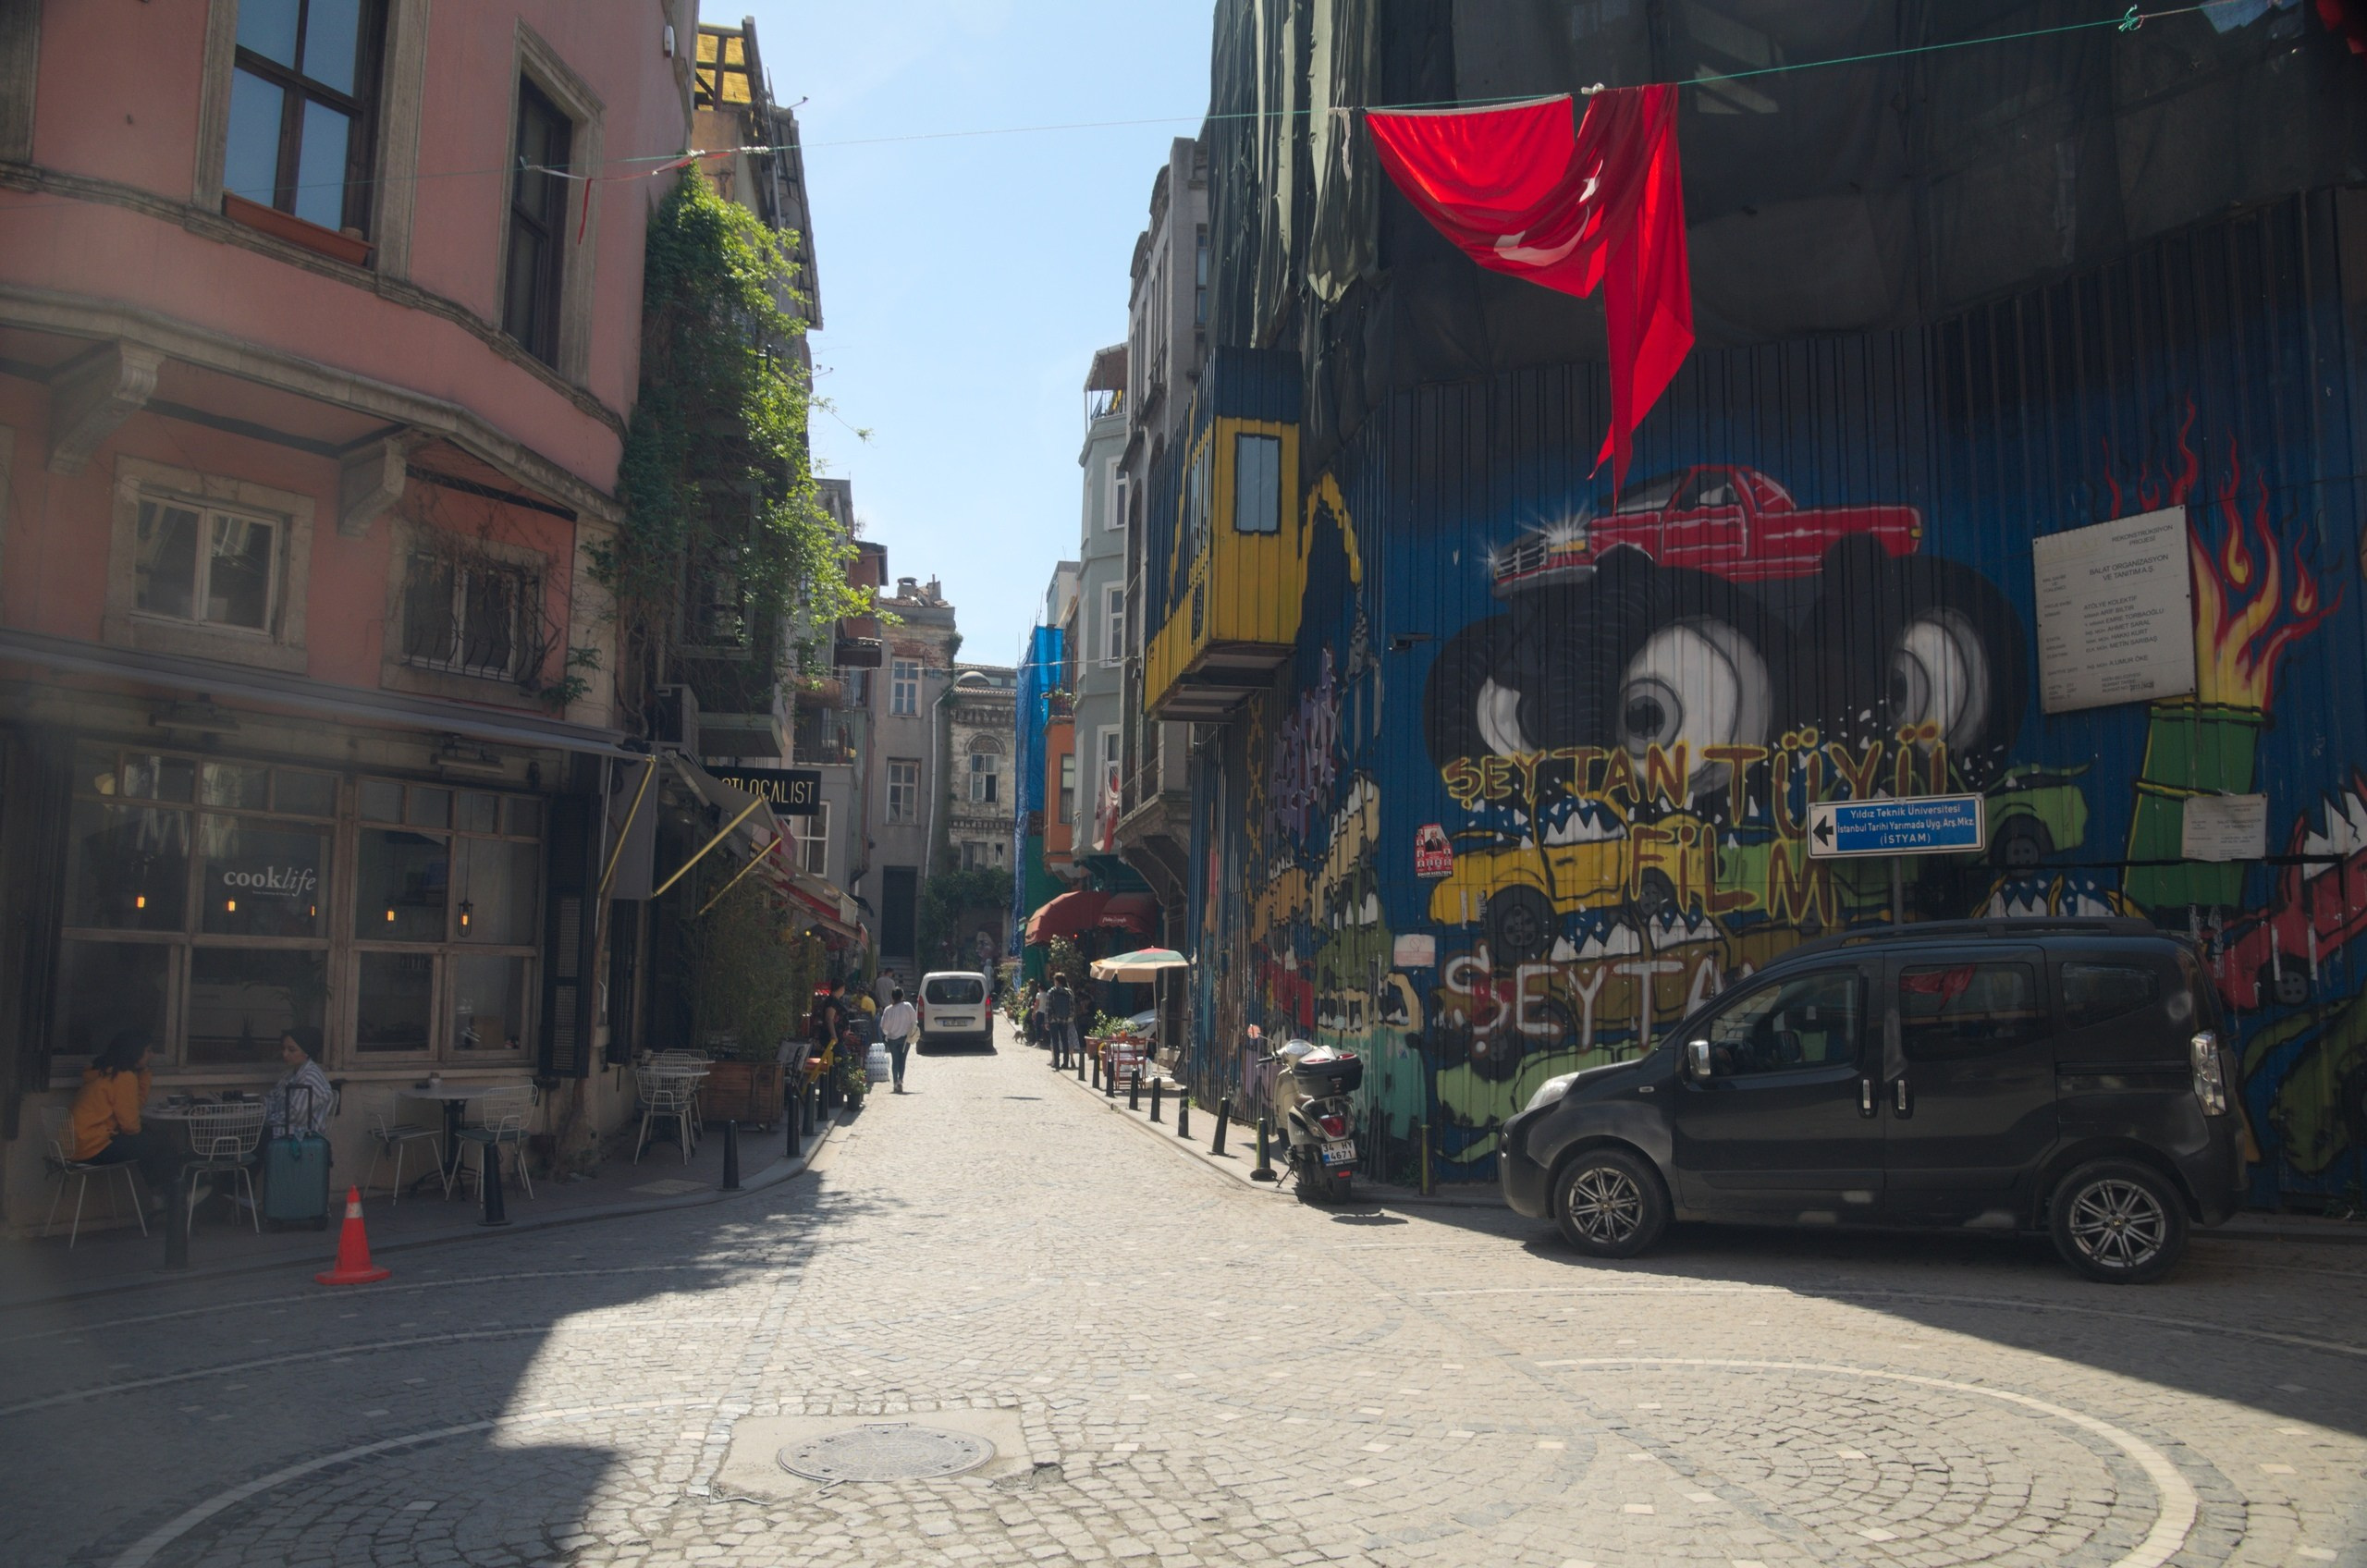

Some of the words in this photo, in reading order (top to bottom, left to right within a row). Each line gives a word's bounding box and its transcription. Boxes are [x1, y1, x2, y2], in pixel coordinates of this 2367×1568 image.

[2089, 565, 2109, 575] BALAT
[2112, 554, 2168, 570] ORGANİZASYON
[2083, 600, 2105, 610] ATÖLYE
[2105, 615, 2123, 623] EMRE
[2107, 622, 2128, 631] AHMET
[2111, 631, 2129, 640] HAKKI
[2130, 628, 2148, 636] KURT
[2109, 640, 2128, 648] METİN
[2134, 654, 2148, 662] ÖKE
[1442, 740, 1690, 810] ŞEYTAN
[1850, 810, 1875, 819] Yıldız
[1876, 807, 1906, 817] Teknik
[1907, 805, 1961, 815] Üniversitesi
[1837, 823, 1867, 833] İstanbul
[1868, 822, 1889, 831] Tarihi
[1890, 820, 1925, 830] Yarımada
[1925, 819, 1942, 830] Uyg.
[1880, 832, 1931, 846] (İSTYAM)
[1628, 822, 1839, 927] FİLM
[223, 865, 316, 898] cooklife
[1444, 940, 1757, 1058] ŞEYTA
[1323, 1144, 1334, 1152] 34
[1341, 1140, 1352, 1149] HY
[1331, 1150, 1353, 1159] 4671
